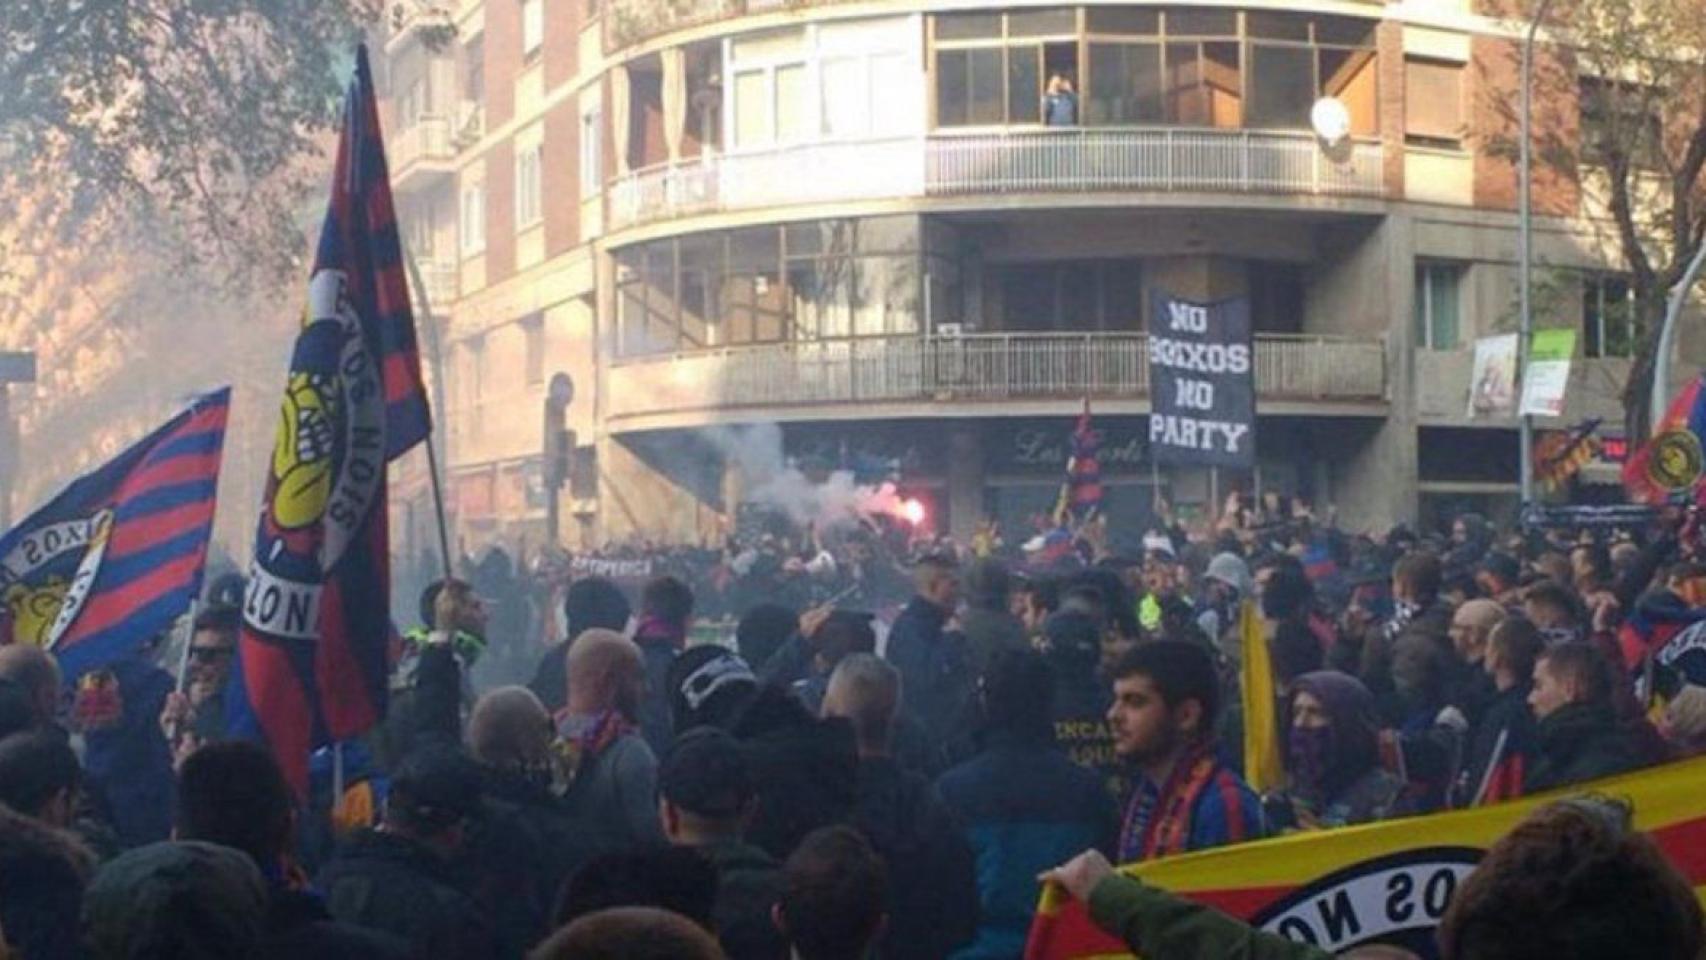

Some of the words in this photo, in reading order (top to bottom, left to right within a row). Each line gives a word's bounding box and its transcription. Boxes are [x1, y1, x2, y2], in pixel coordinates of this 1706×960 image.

[1168, 301, 1207, 332] NO
[1148, 336, 1250, 373] BOIXOS
[1175, 378, 1213, 410] NO
[1149, 413, 1249, 452] PARTY
